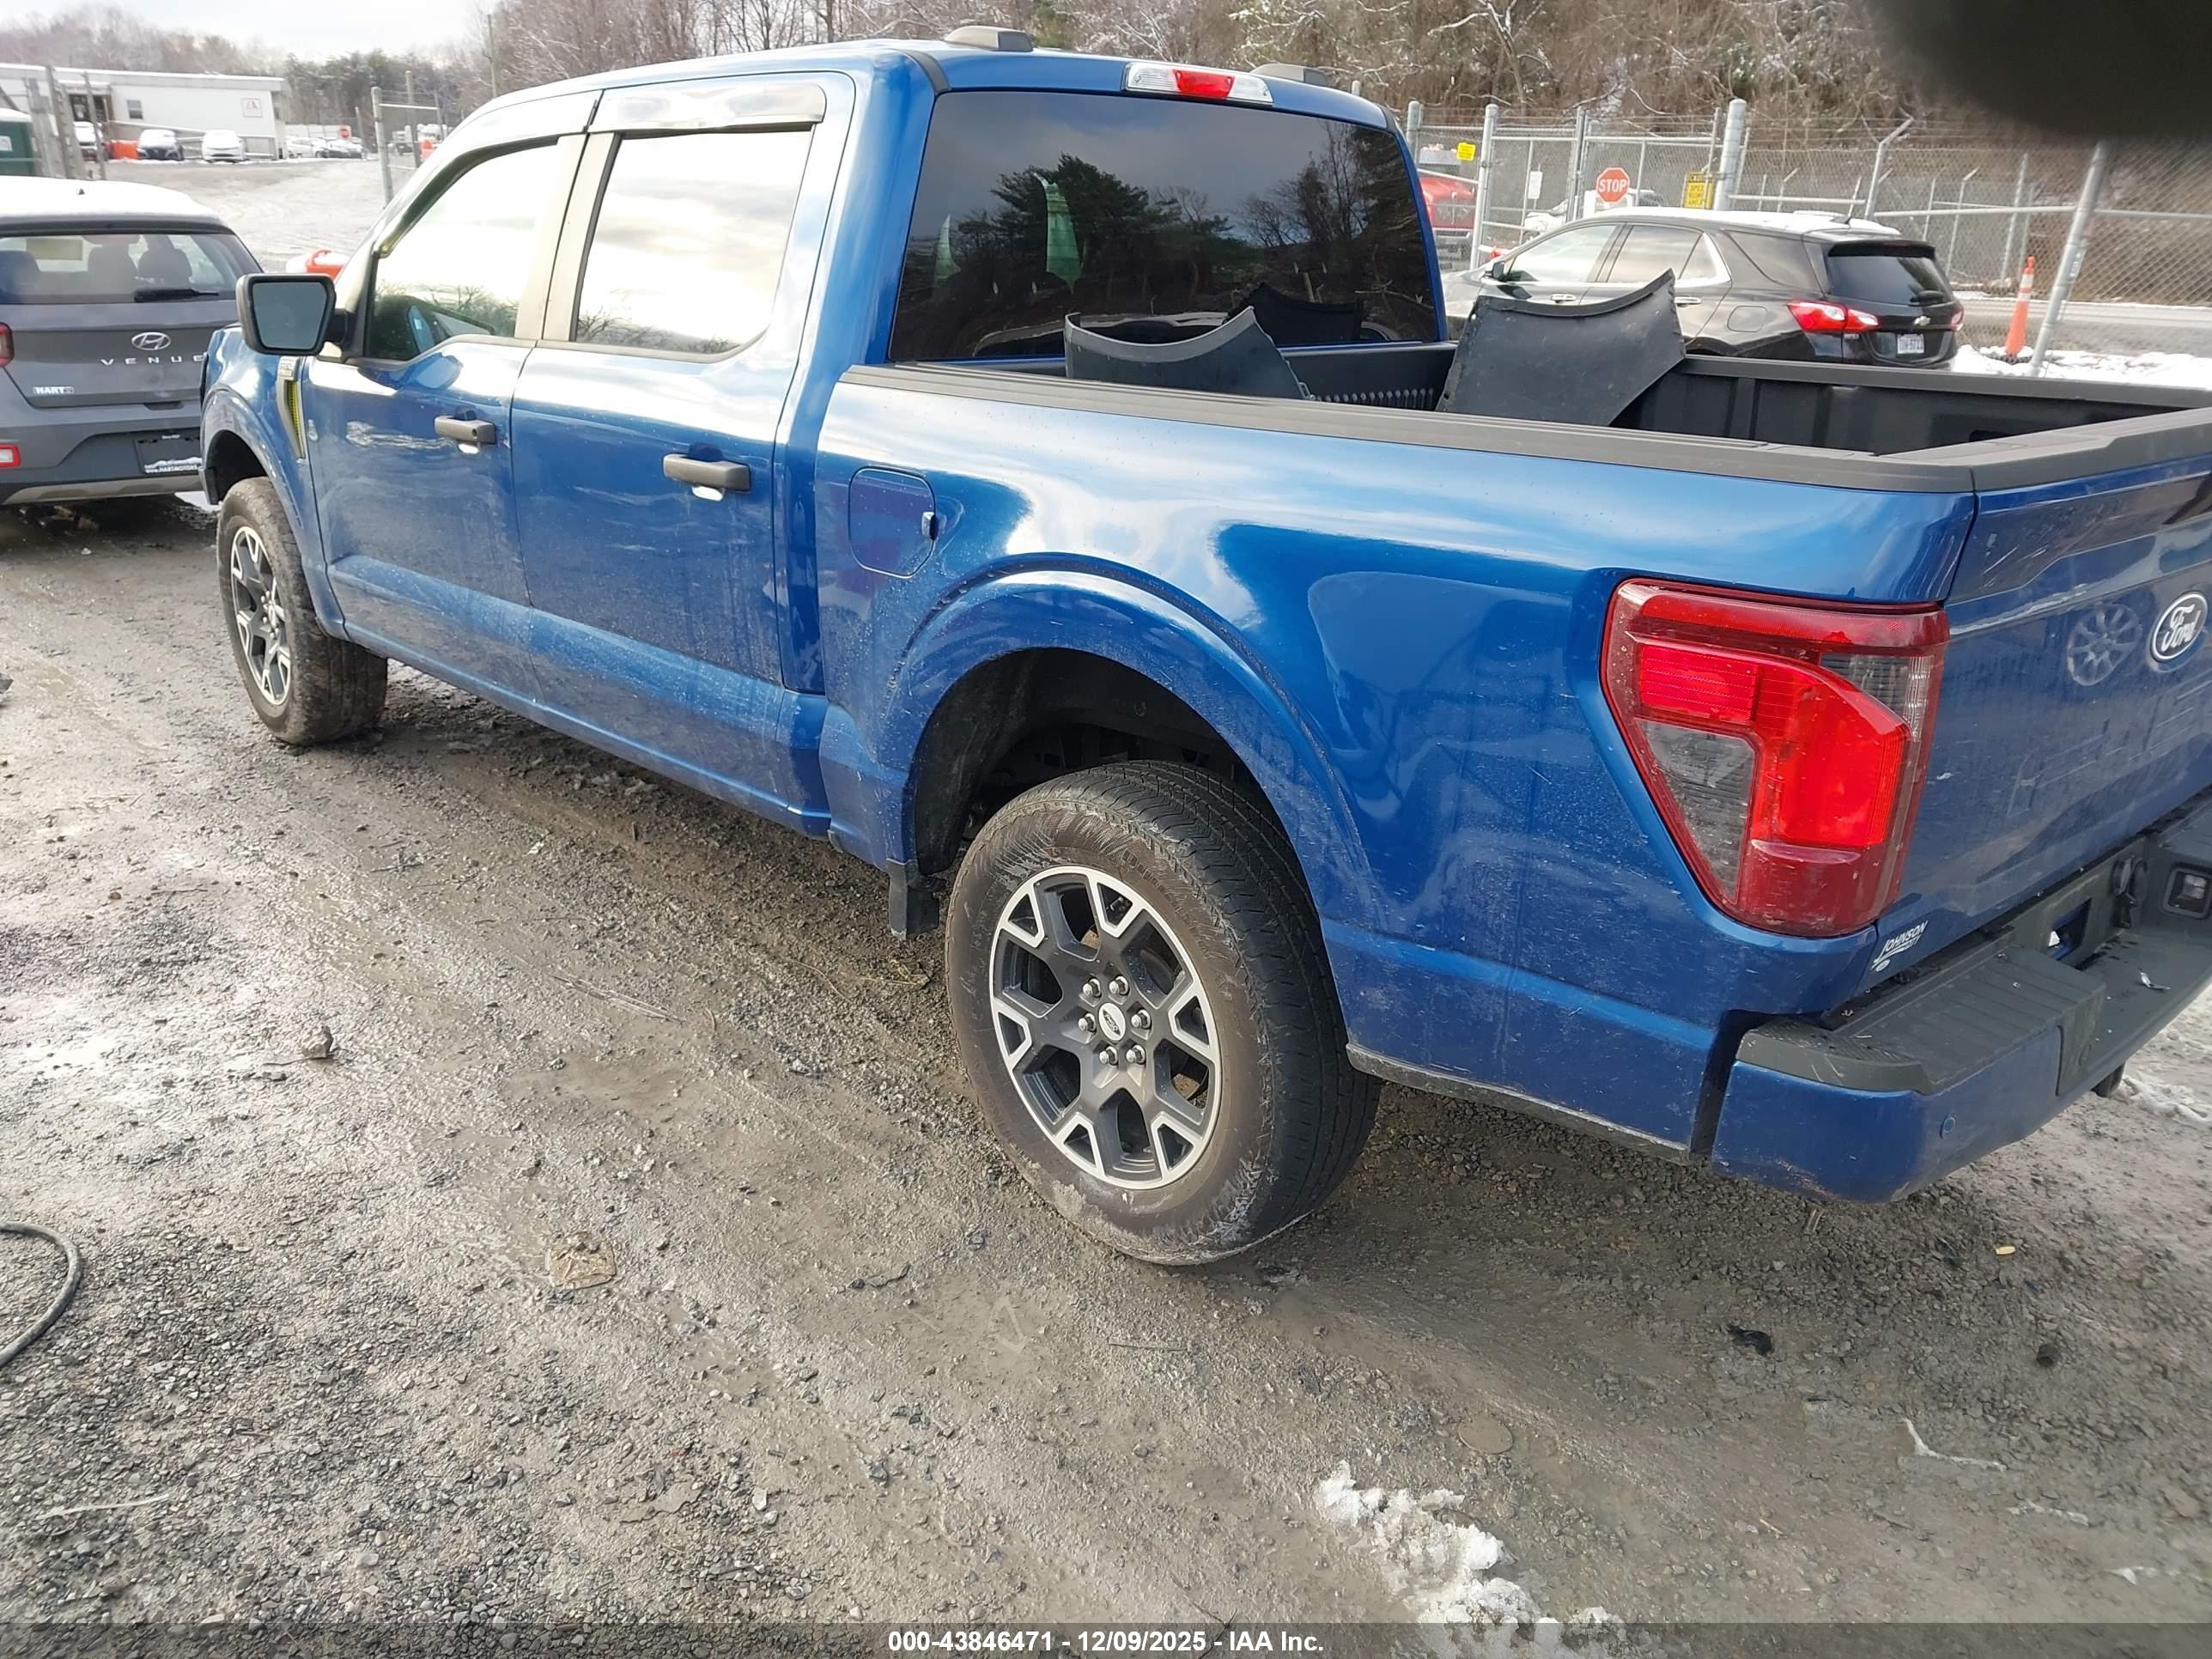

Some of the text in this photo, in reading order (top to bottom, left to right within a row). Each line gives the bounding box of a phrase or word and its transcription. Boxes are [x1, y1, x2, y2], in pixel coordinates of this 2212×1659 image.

[1599, 179, 1627, 192] STOP
[100, 354, 205, 366] VENUE
[2160, 604, 2203, 652] Ford
[1874, 920, 1929, 963] JOHNSON
